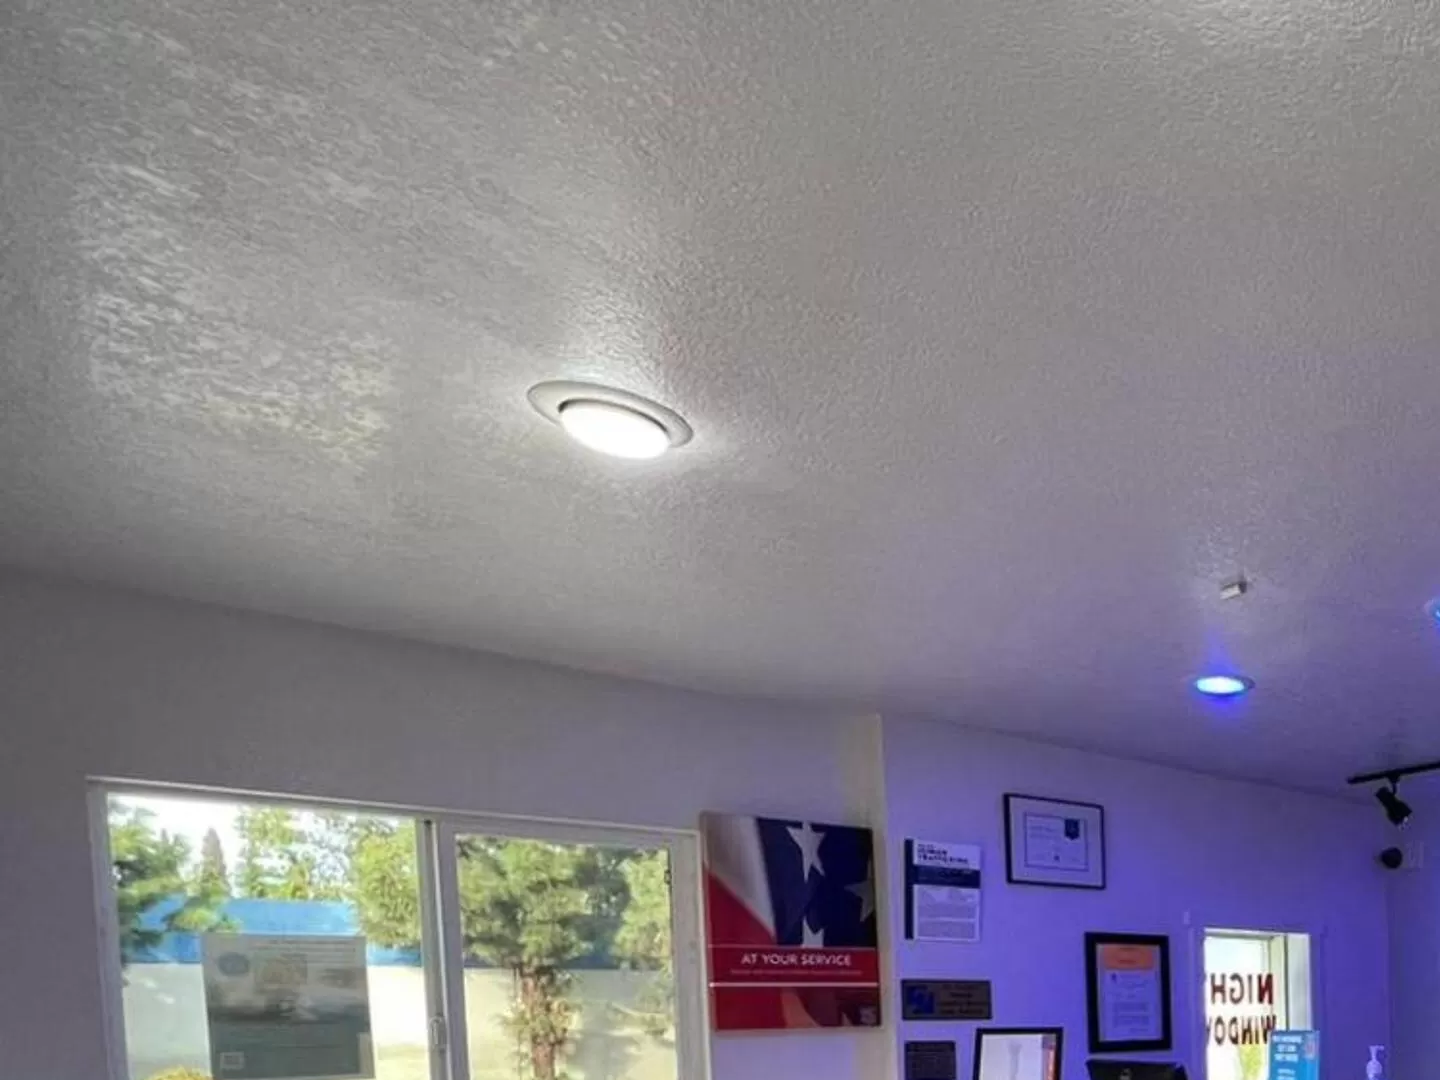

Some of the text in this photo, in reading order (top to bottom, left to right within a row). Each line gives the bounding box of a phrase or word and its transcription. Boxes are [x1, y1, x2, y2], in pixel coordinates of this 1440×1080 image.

[741, 954, 851, 966] AT YOUR SERVICE
